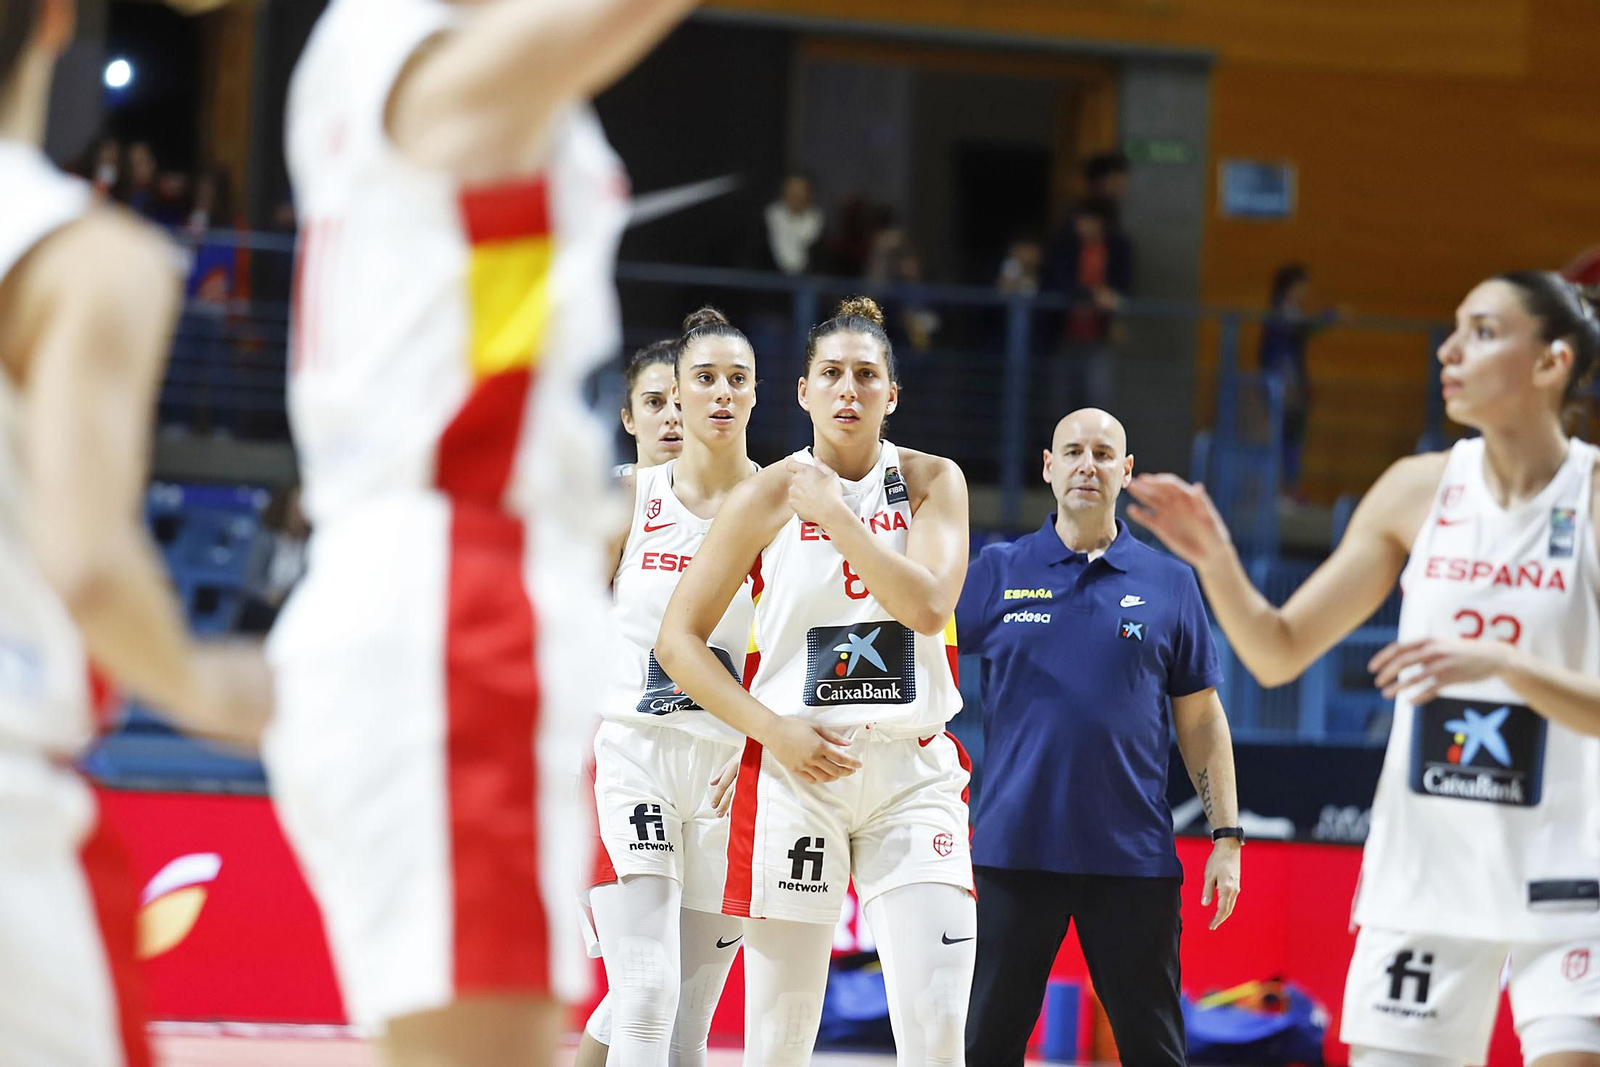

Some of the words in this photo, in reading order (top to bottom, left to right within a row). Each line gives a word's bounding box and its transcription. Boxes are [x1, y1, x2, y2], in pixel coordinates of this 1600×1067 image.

[888, 484, 905, 496] FIBA
[842, 559, 871, 600] 8
[1425, 556, 1566, 592] ESPAÑA
[1003, 588, 1053, 600] ESPAÑA
[1003, 610, 1051, 624] endesa
[816, 681, 902, 701] CaixaBank
[629, 803, 666, 841] fi
[629, 841, 675, 853] network
[787, 836, 825, 881] fi
[778, 880, 829, 893] network
[1386, 949, 1434, 1004] fi
